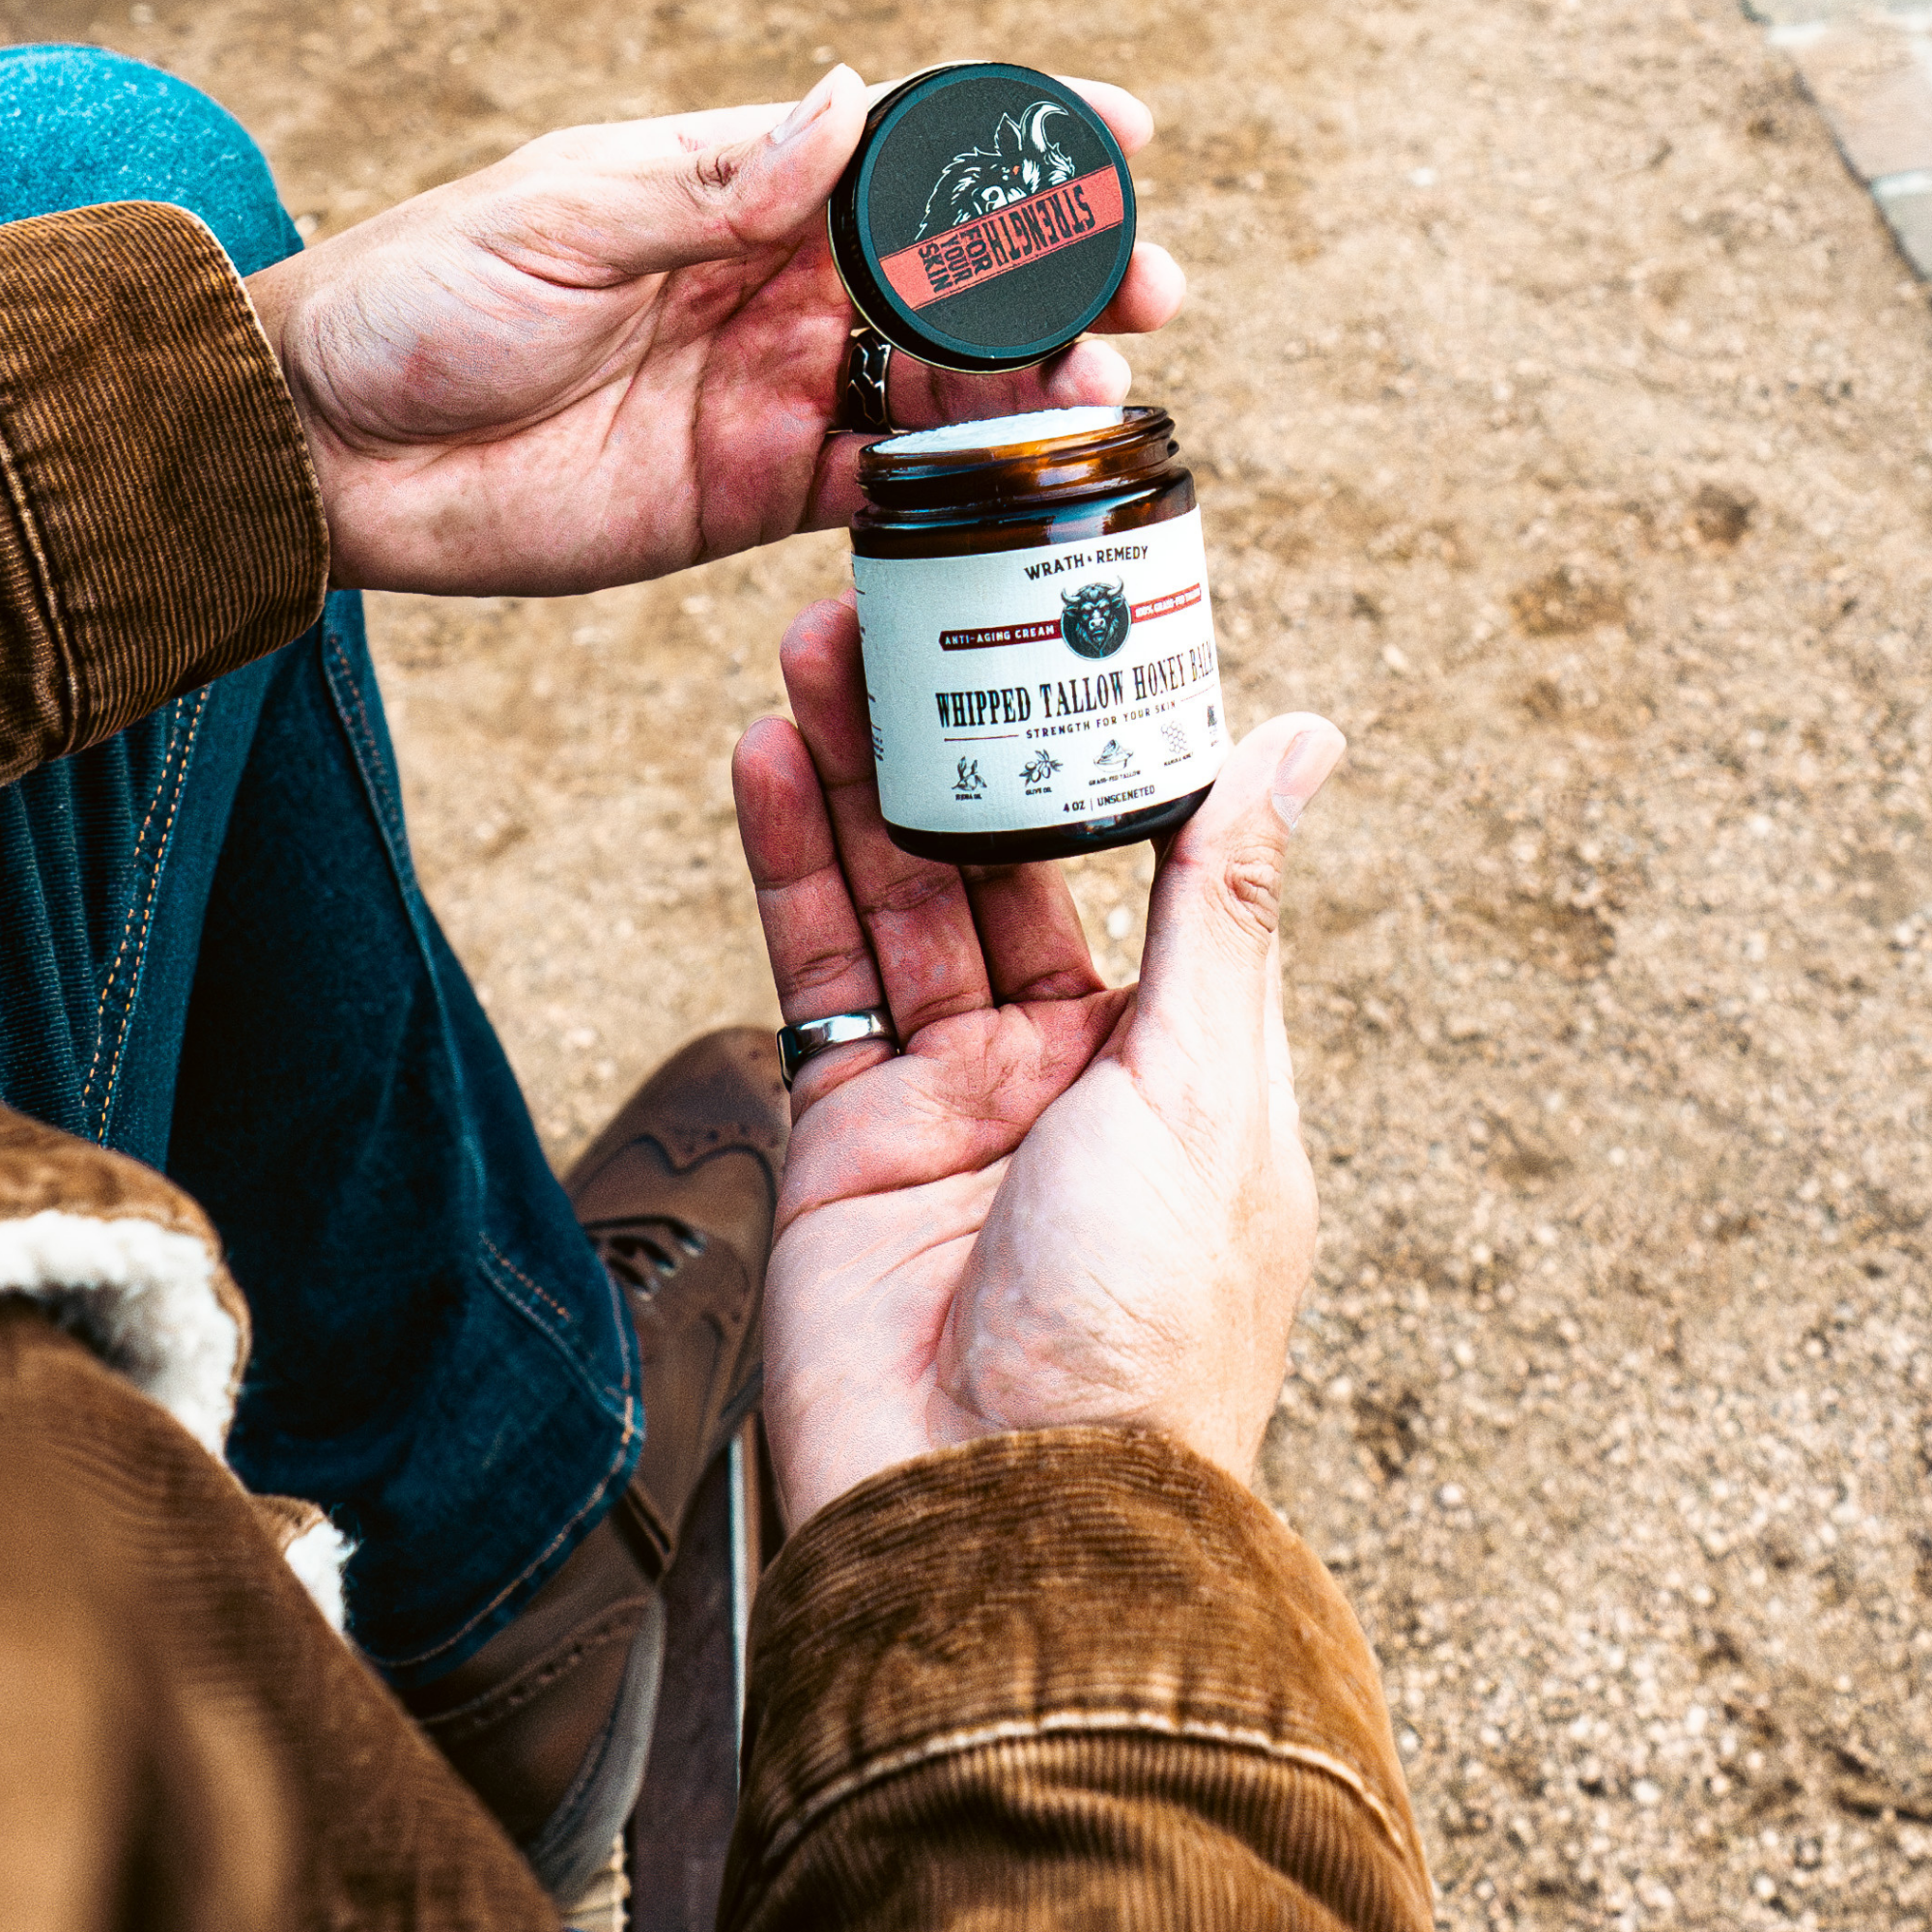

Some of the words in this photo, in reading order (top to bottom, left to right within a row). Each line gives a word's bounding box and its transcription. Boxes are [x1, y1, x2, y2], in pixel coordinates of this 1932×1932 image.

[959, 225, 993, 278] FOR
[981, 185, 1096, 267] STRENGTH
[919, 242, 952, 294] SKIN
[940, 233, 973, 285] YOUR
[1024, 554, 1085, 581] WRATH
[1096, 546, 1149, 564] REMEDY
[945, 631, 1011, 645] ANTI-AGING
[1014, 625, 1055, 639] CREAM
[935, 687, 1032, 728] WHIPPED
[1039, 670, 1123, 718] TALLOW
[1132, 652, 1185, 701] HONEY
[1026, 721, 1091, 739] STRENGTH
[1096, 716, 1118, 728] FOR
[1123, 708, 1151, 722] YOUR
[1154, 699, 1176, 714] SKIN
[1063, 803, 1069, 812] 4
[1071, 800, 1086, 811] OZ
[1096, 784, 1155, 807] UNSCENETED
